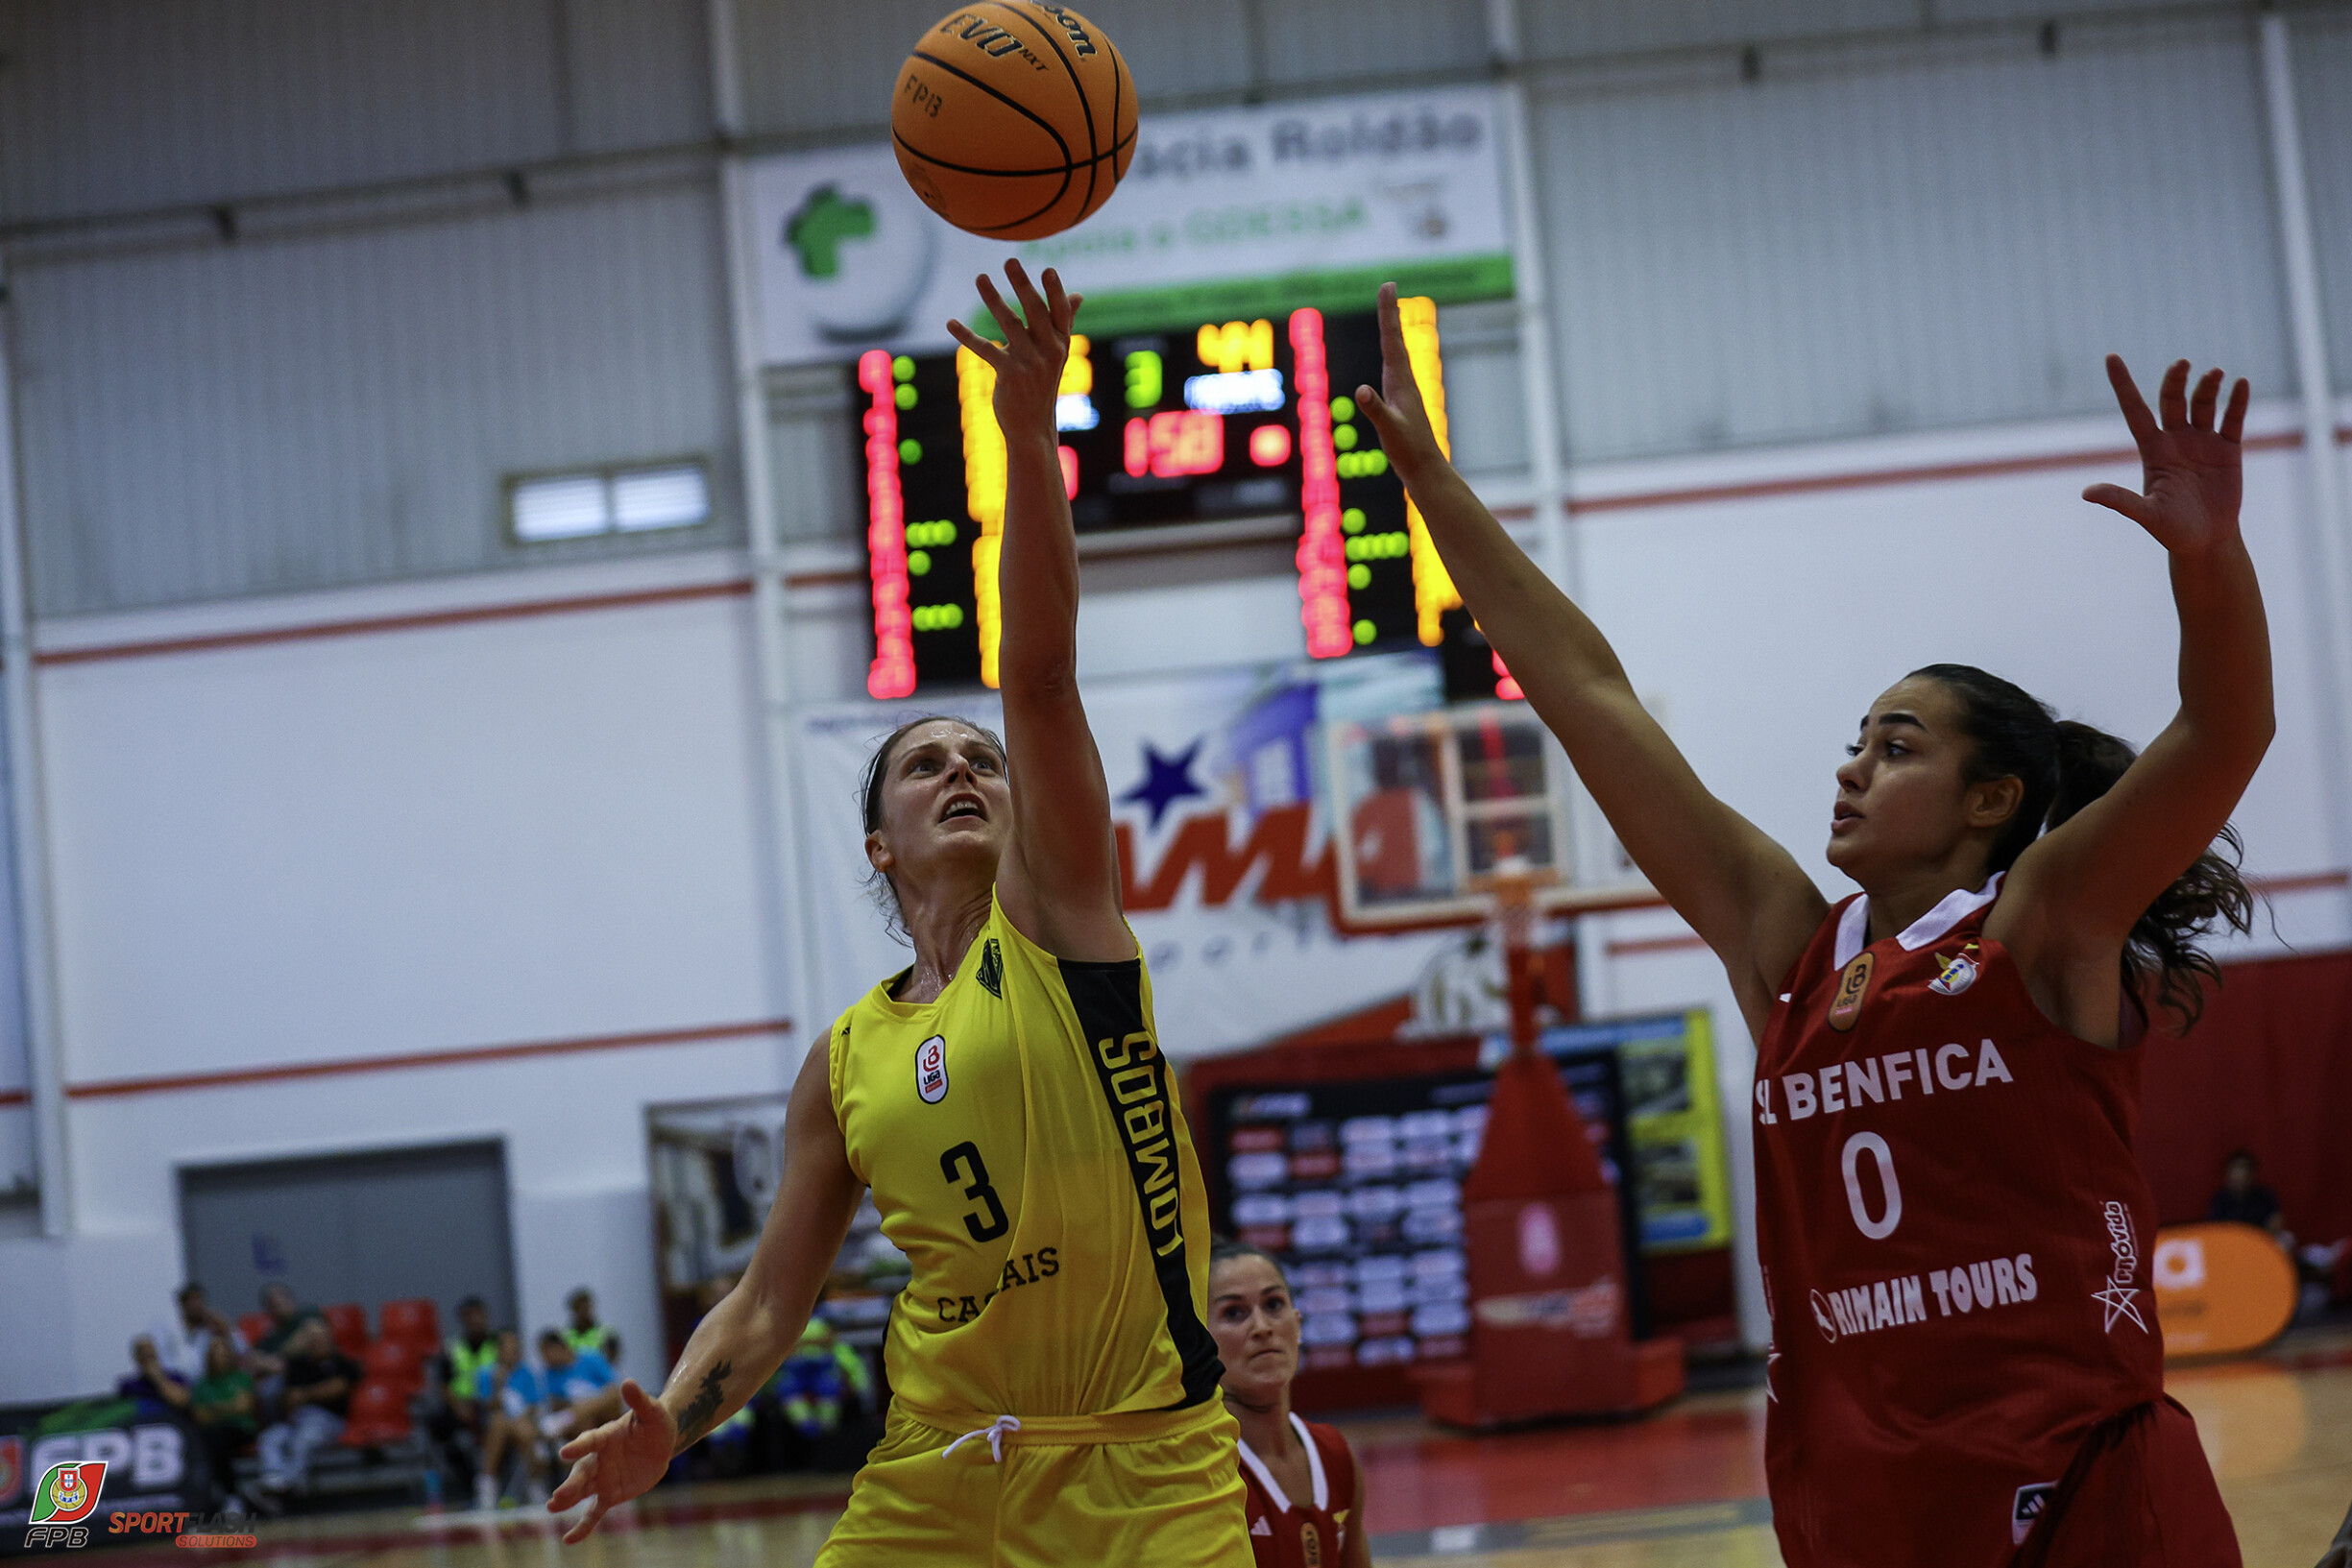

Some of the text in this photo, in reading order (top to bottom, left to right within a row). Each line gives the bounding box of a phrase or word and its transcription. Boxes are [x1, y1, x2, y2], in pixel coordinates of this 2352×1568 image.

[940, 13, 1049, 72] EVO NXT
[904, 75, 943, 118] FPB
[1125, 350, 1163, 408] 3
[1782, 1039, 2014, 1121] BENFICA
[1098, 1030, 1184, 1257] LOMBOS
[940, 1141, 1009, 1242] 3
[1841, 1131, 1903, 1240] 0
[1828, 1275, 1927, 1336] RIMAIN
[1929, 1253, 2038, 1316] TOURS
[31, 1422, 184, 1494] FPB
